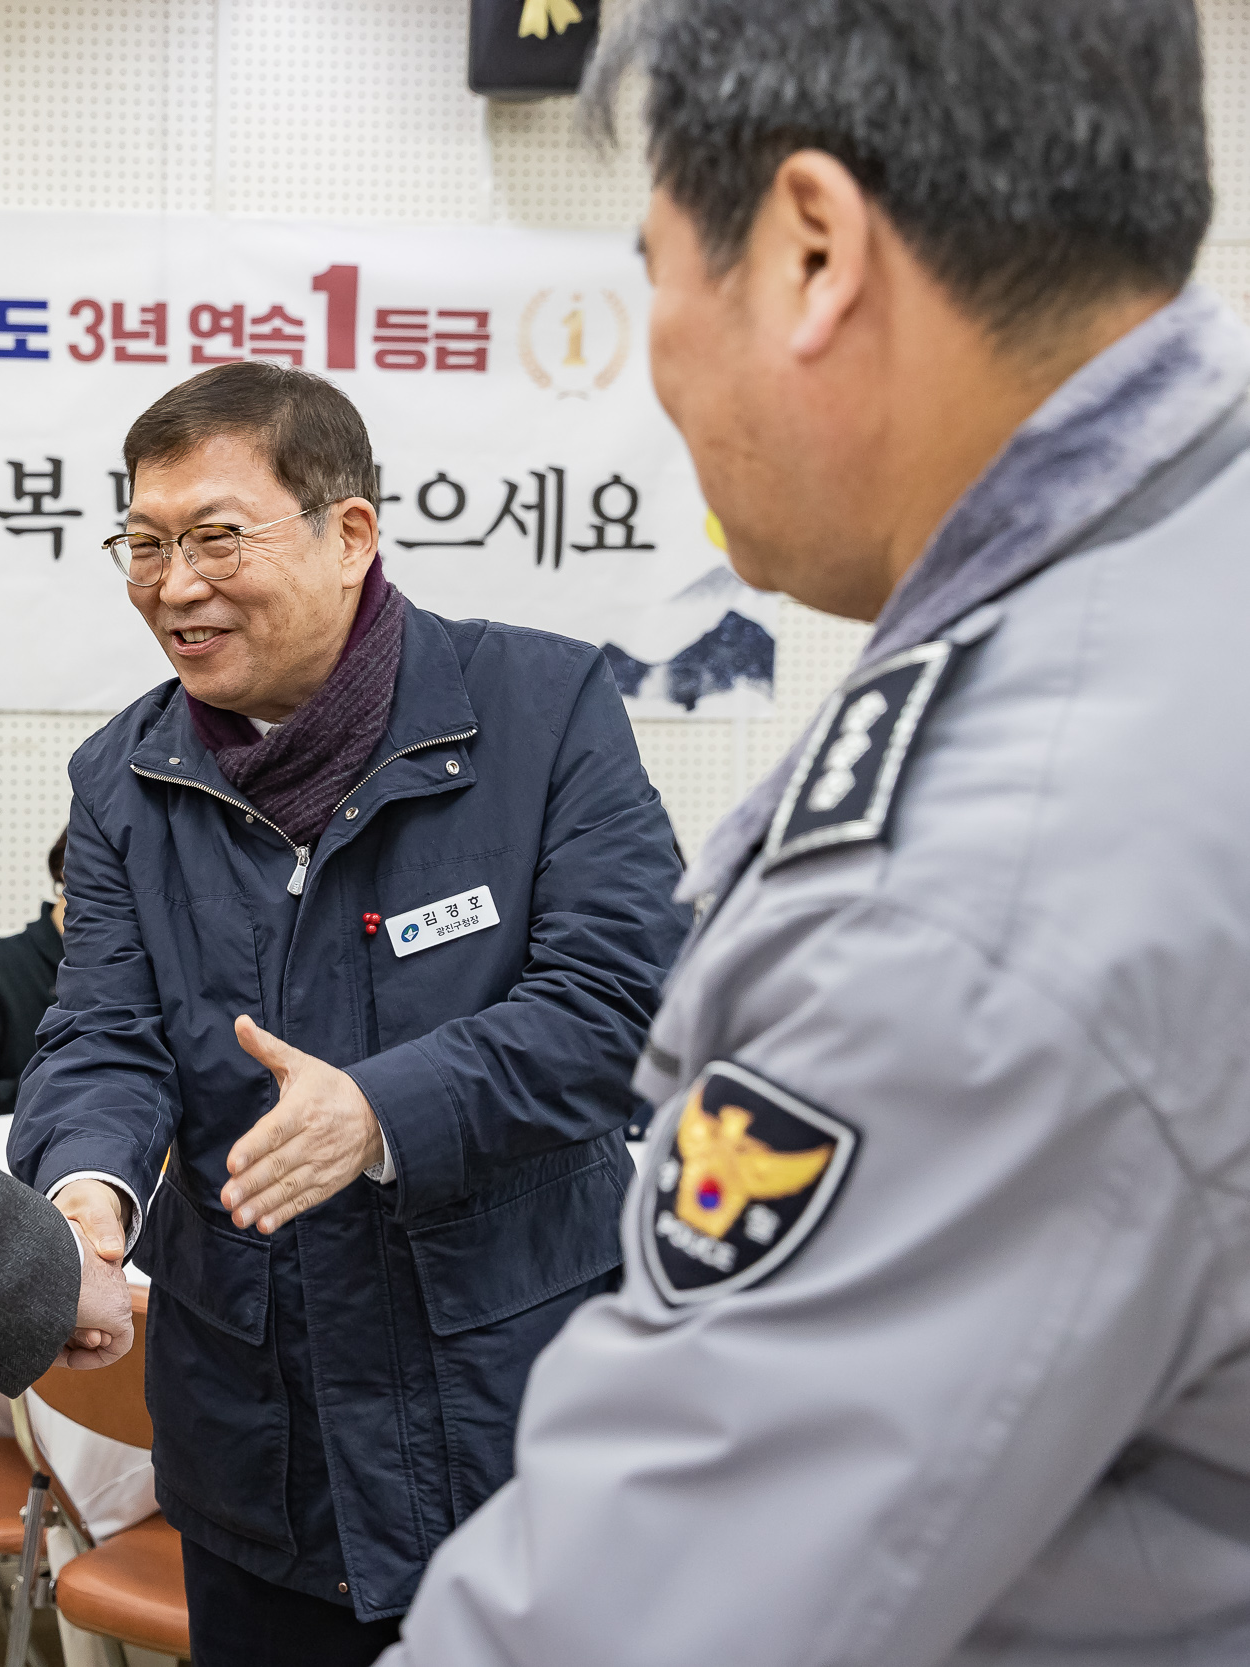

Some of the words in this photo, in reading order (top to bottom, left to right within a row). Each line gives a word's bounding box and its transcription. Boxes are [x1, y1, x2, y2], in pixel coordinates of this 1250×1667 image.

[68, 299, 168, 363] 3년
[374, 464, 655, 569] 으세요
[435, 914, 480, 937] 광진구청장
